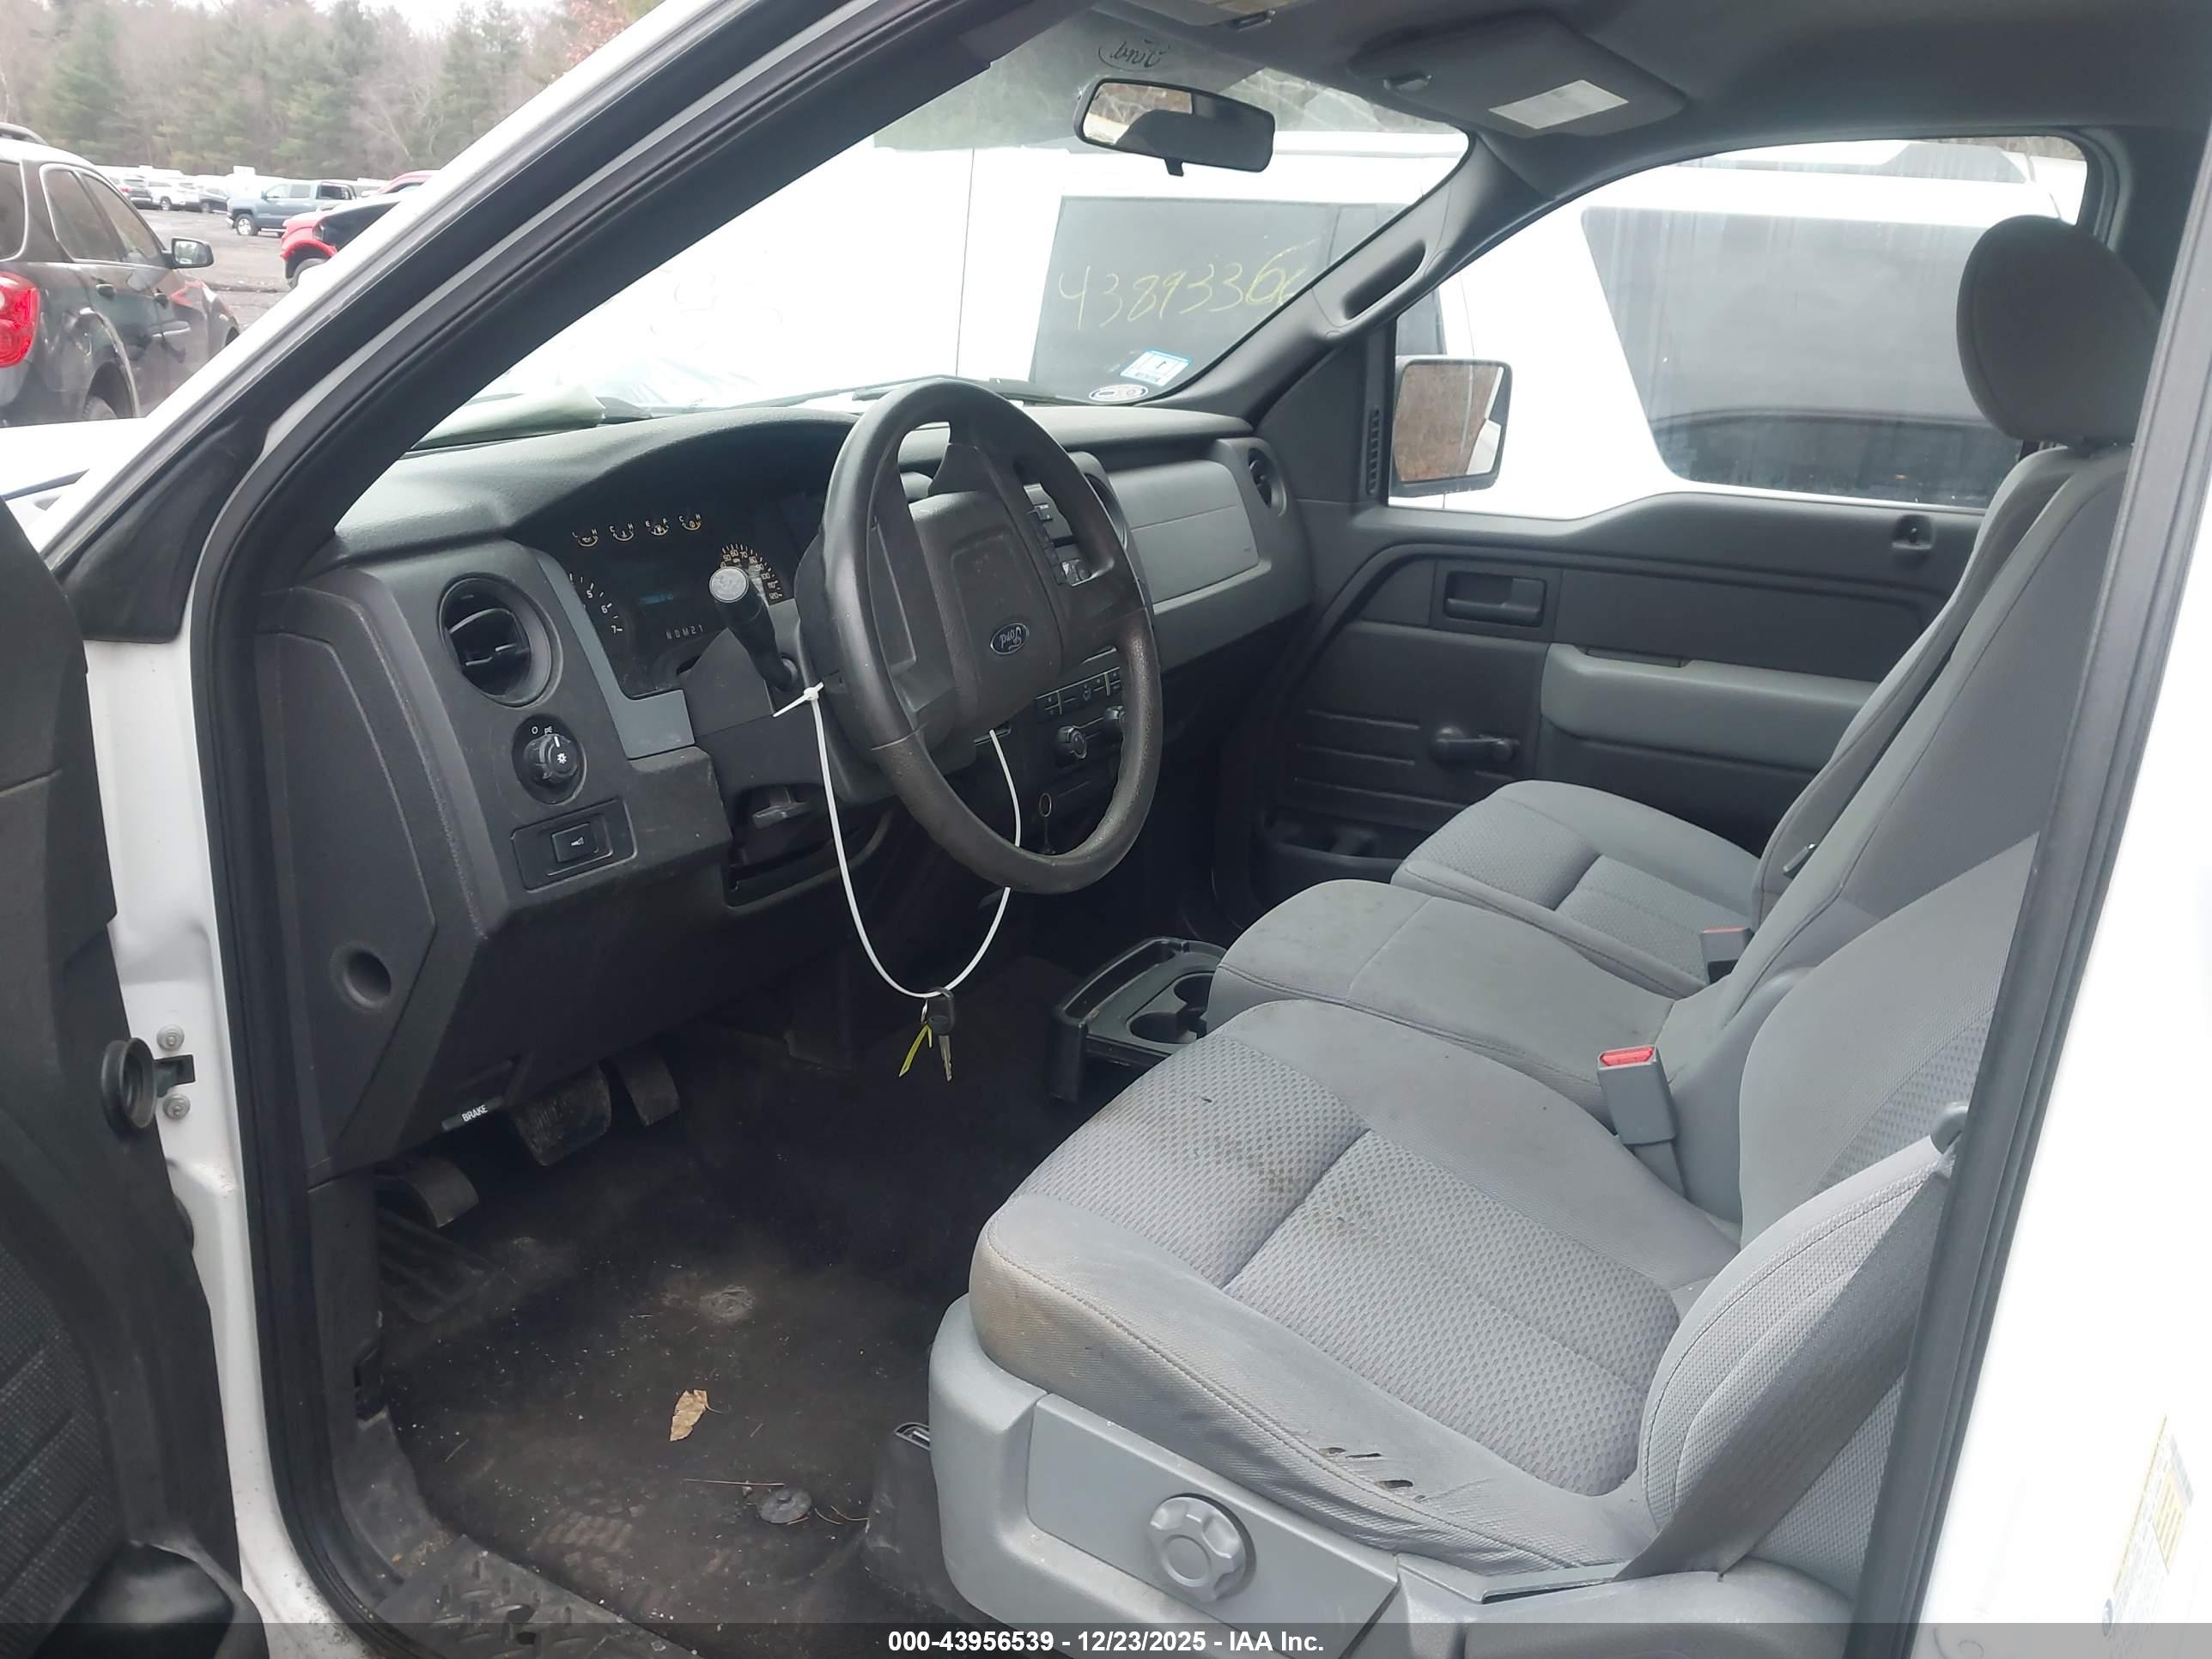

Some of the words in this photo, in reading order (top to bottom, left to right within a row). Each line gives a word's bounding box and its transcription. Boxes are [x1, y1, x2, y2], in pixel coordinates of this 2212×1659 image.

[586, 589, 593, 599] 5
[601, 605, 609, 614] 6
[999, 626, 1022, 650] Ford
[461, 1104, 488, 1121] BRAKE
